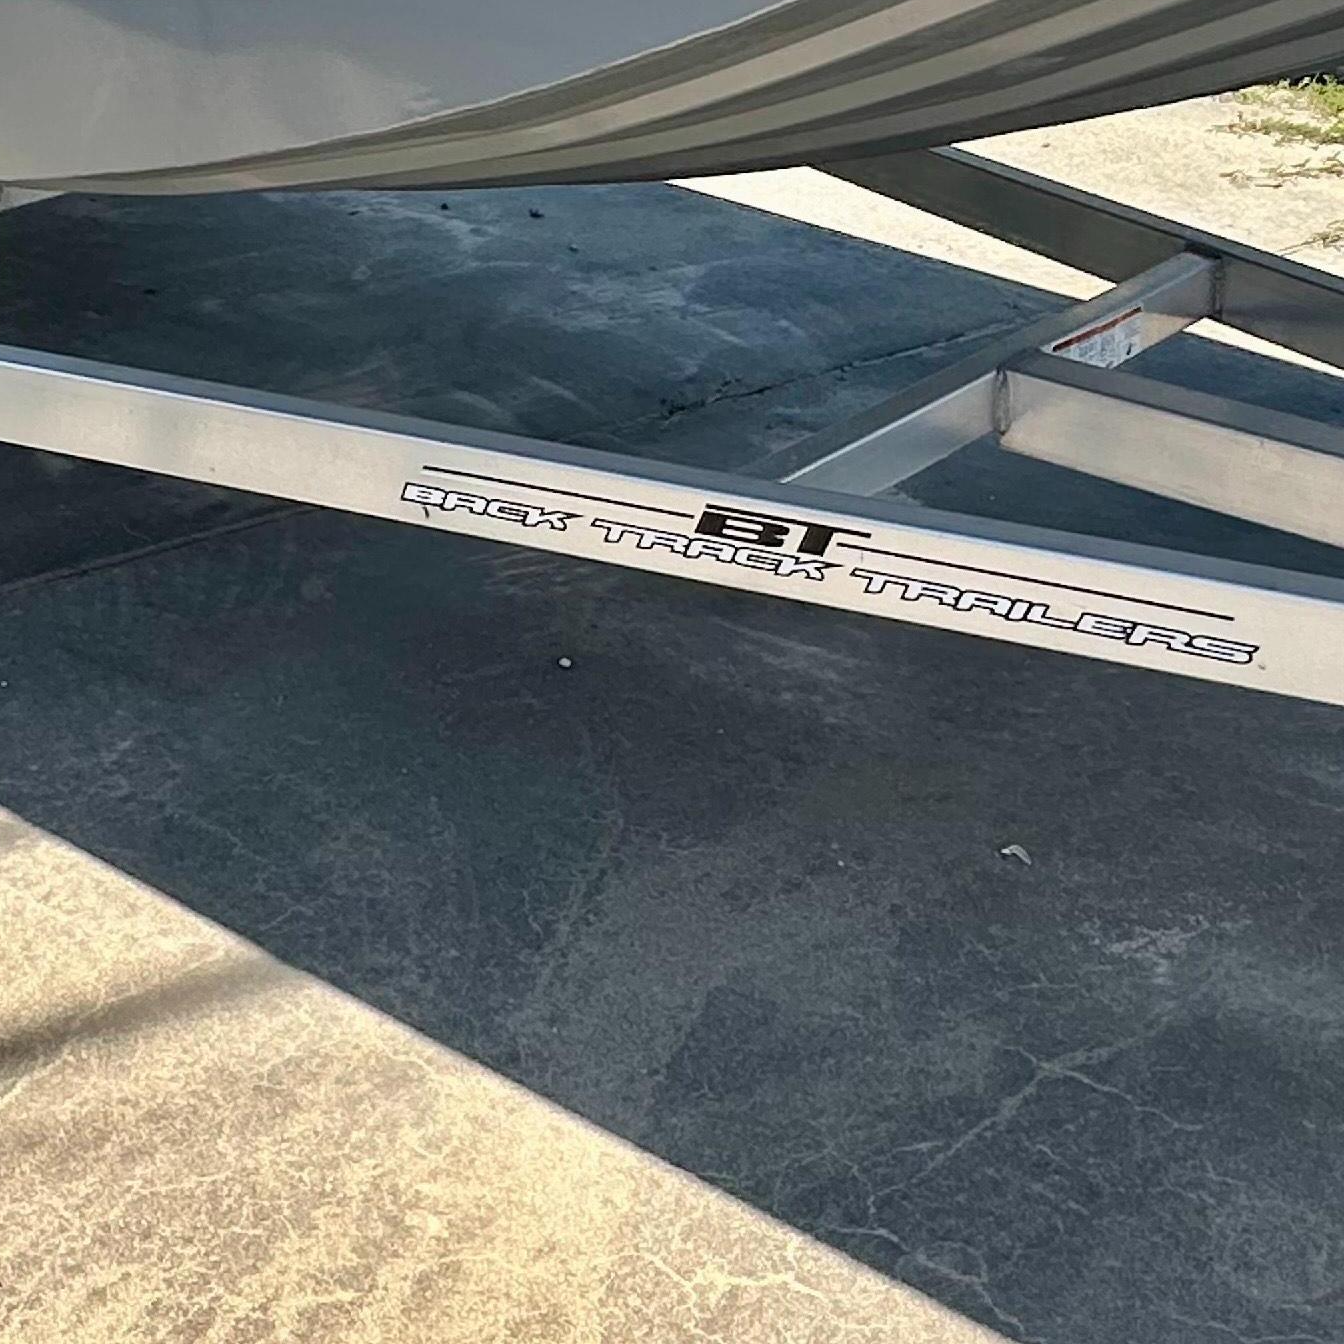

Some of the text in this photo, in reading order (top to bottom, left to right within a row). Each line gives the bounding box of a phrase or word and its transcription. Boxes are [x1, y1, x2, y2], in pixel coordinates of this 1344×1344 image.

[401, 482, 1260, 666] BACK TRACK TRAILERS
[694, 503, 872, 558] BT
